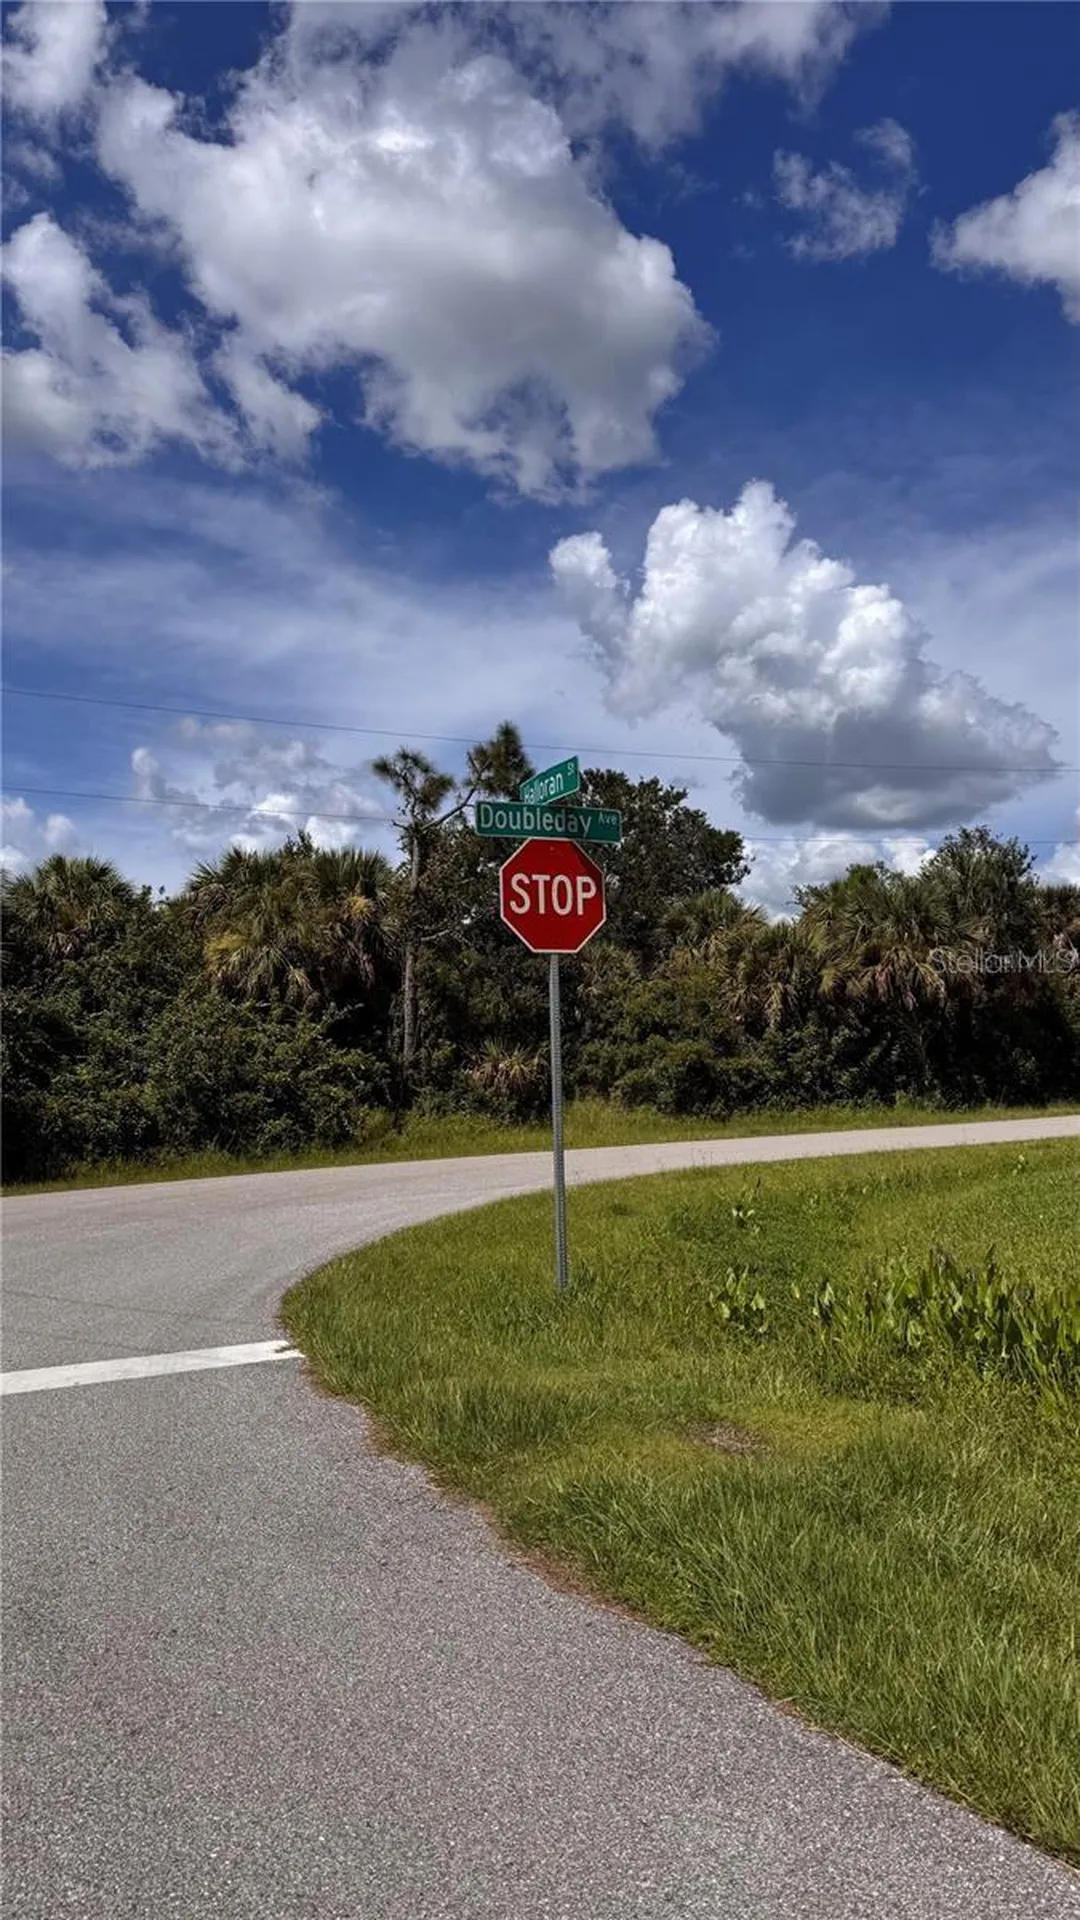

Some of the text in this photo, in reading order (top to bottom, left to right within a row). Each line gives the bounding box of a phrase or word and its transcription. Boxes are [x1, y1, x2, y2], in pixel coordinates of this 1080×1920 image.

[524, 773, 564, 804] Halloran
[480, 804, 618, 838] Doubleday Ave
[509, 873, 597, 916] STOP
